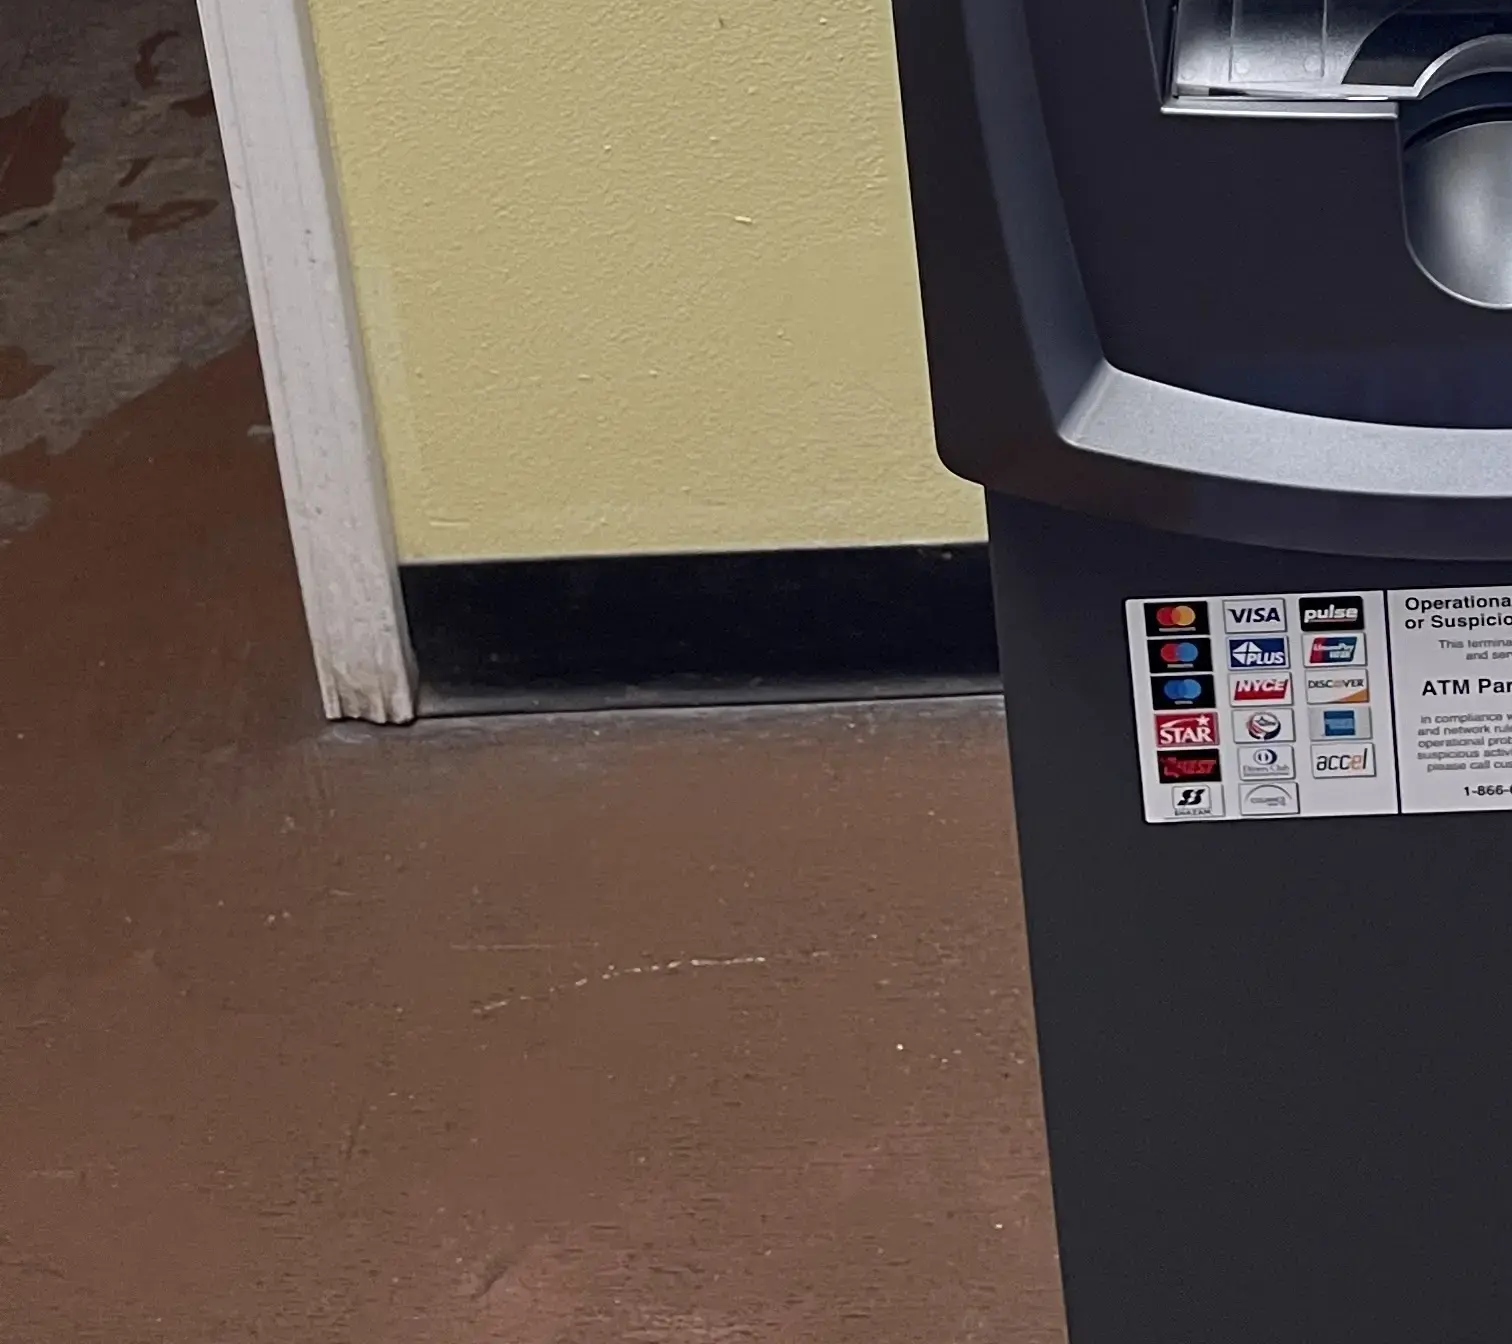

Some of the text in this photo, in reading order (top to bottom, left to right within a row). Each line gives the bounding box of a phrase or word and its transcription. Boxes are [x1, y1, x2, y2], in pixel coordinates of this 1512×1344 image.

[1228, 607, 1281, 623] VISA
[1304, 605, 1358, 623] pulse
[1405, 618, 1424, 629] or
[1439, 640, 1464, 648] This
[1248, 651, 1285, 665] PLUS
[1466, 651, 1488, 660] and
[1237, 679, 1286, 692] NYCE
[1308, 679, 1364, 689] DISCOVER
[1422, 680, 1470, 696] ATM
[1160, 728, 1213, 744] STAR
[1444, 725, 1490, 735] network
[1316, 748, 1368, 771] accel
